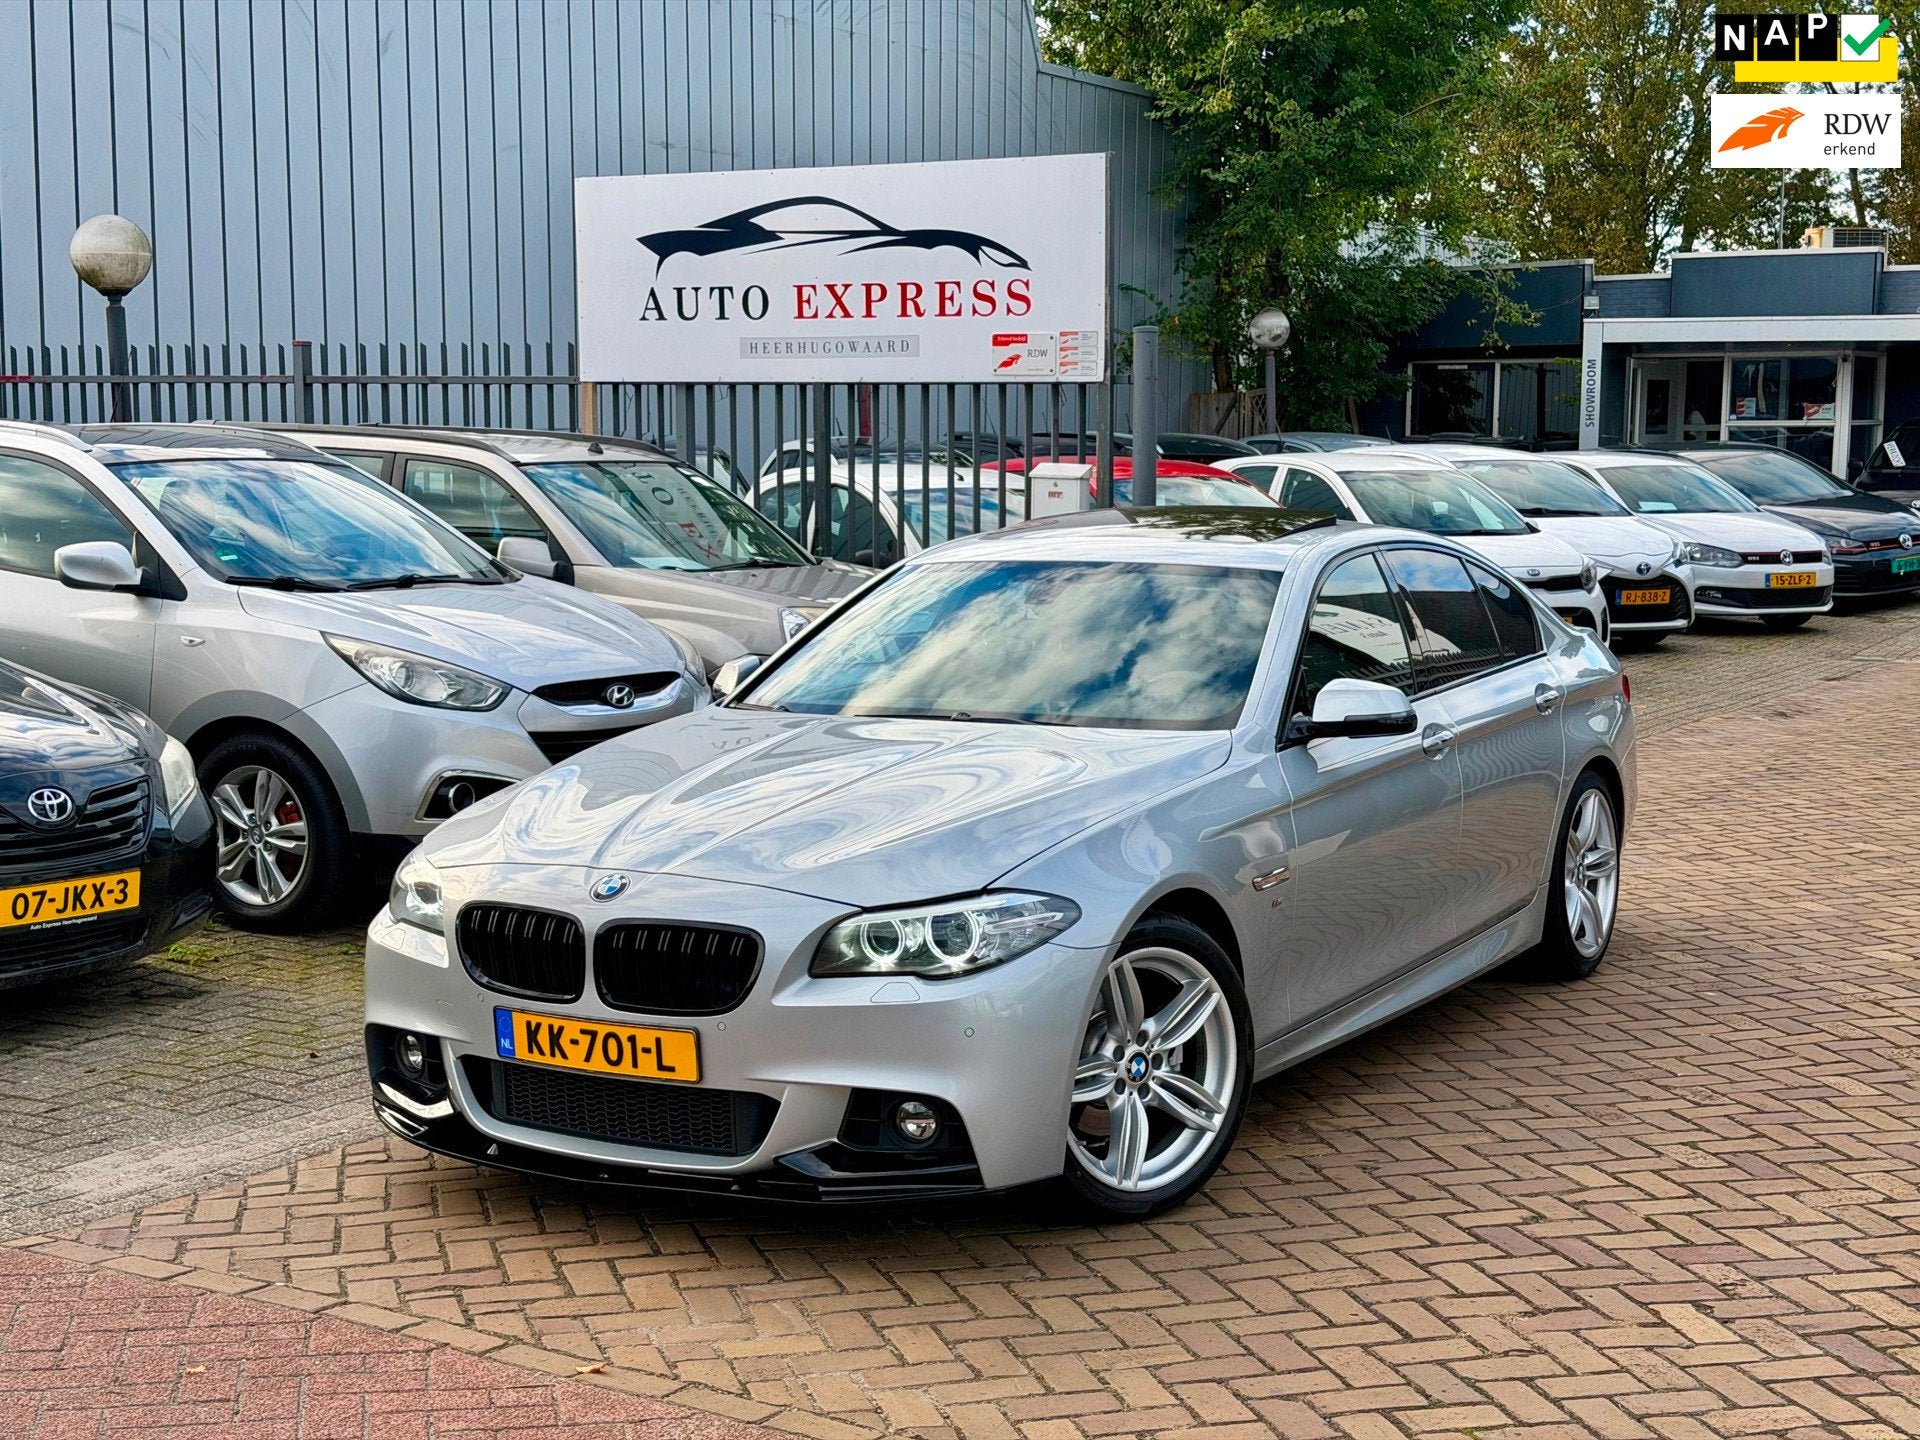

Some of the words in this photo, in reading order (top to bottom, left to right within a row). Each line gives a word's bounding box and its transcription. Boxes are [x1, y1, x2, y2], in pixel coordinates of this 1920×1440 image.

[639, 285, 770, 321] AUTO
[793, 278, 1033, 320] EXPRESS
[748, 338, 912, 355] HEERHUGOWAARD
[1027, 349, 1048, 358] RDW
[1585, 358, 1597, 428] SHOWROOM
[1775, 575, 1811, 585] 15-ZLF-2
[11, 878, 129, 920] 07-JKX-3
[500, 1037, 514, 1050] NL
[525, 1019, 676, 1073] KK-701-L
